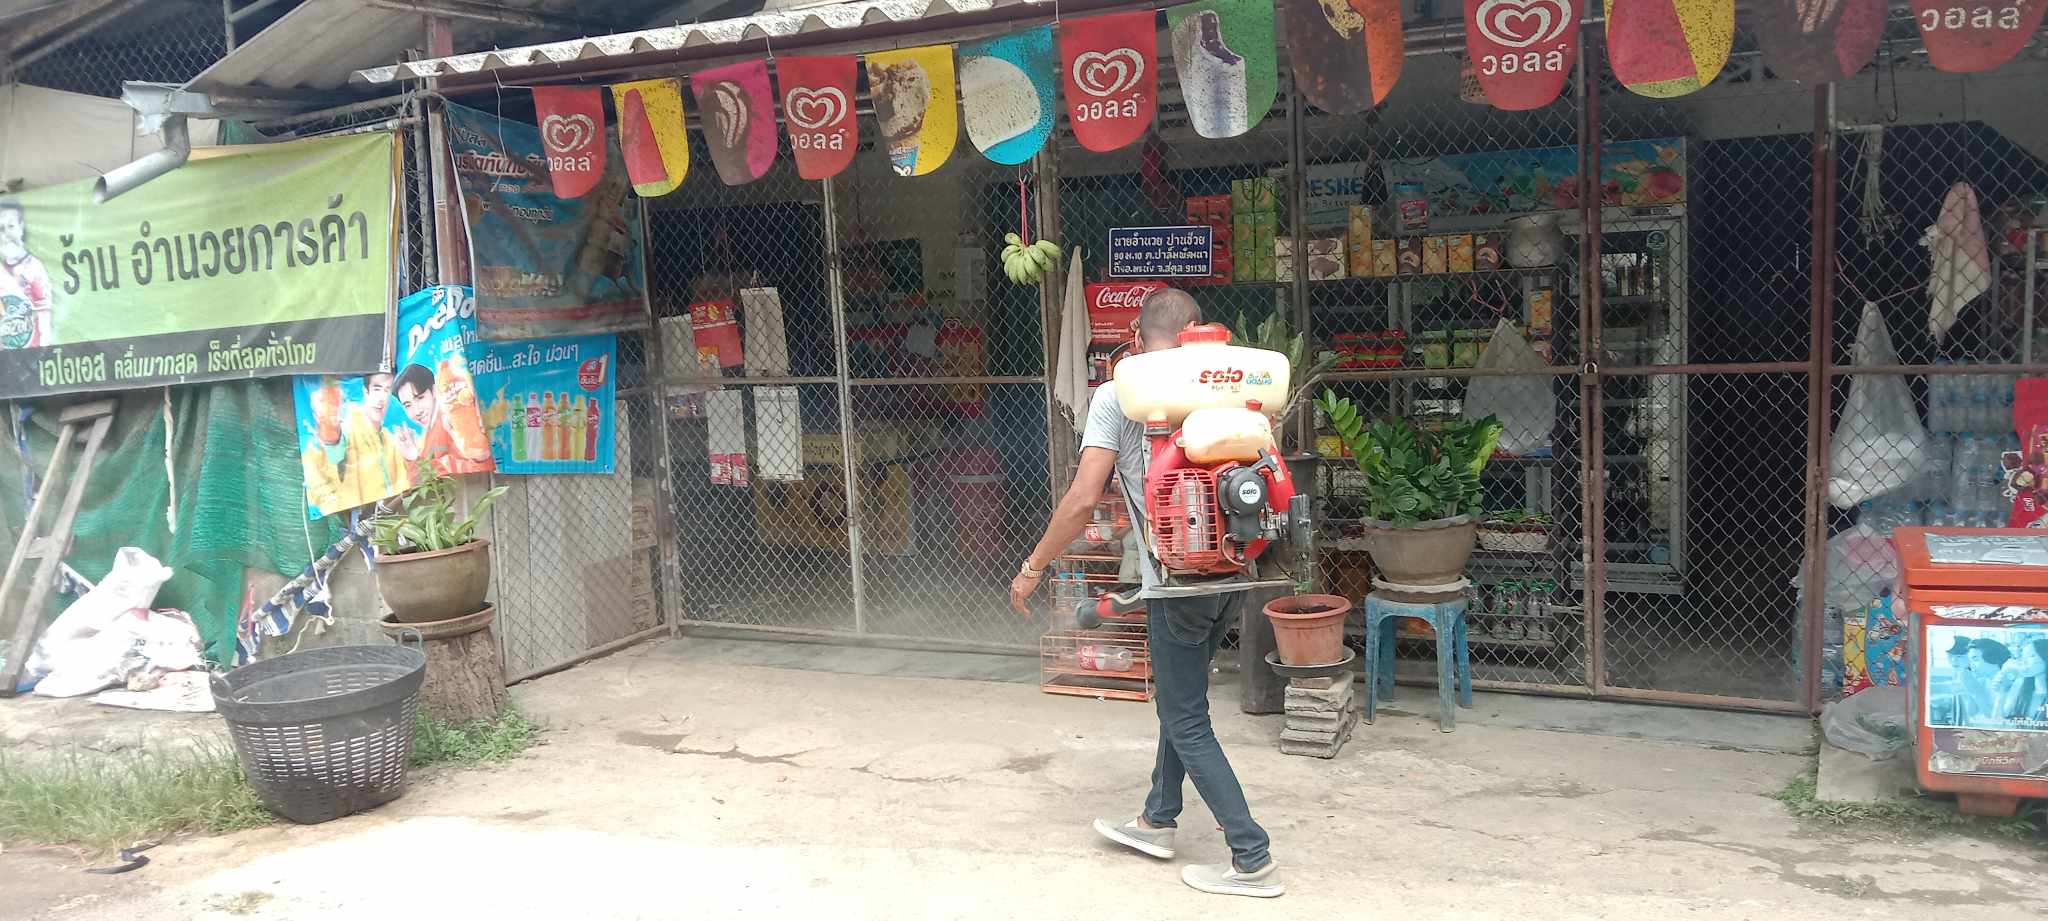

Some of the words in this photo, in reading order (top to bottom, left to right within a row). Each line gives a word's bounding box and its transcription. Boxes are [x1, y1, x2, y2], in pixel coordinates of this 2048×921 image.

[1481, 43, 1567, 75] วอลล์
[1076, 93, 1141, 121] วอลล์
[790, 128, 845, 150] วอลล์
[60, 233, 120, 295] ร้าน
[132, 193, 369, 286] อำนวยการค้า
[1114, 232, 1163, 247] นายอำนวย
[1185, 264, 1207, 273] 91130
[1096, 286, 1156, 309] Coca-Col
[39, 348, 106, 387] เอไอเอส
[114, 345, 198, 384] คลื่นมากสุด
[207, 330, 316, 378] เร็วที่สุดทั่วไทย
[1199, 367, 1243, 384] solo
[1241, 487, 1257, 495] solo
